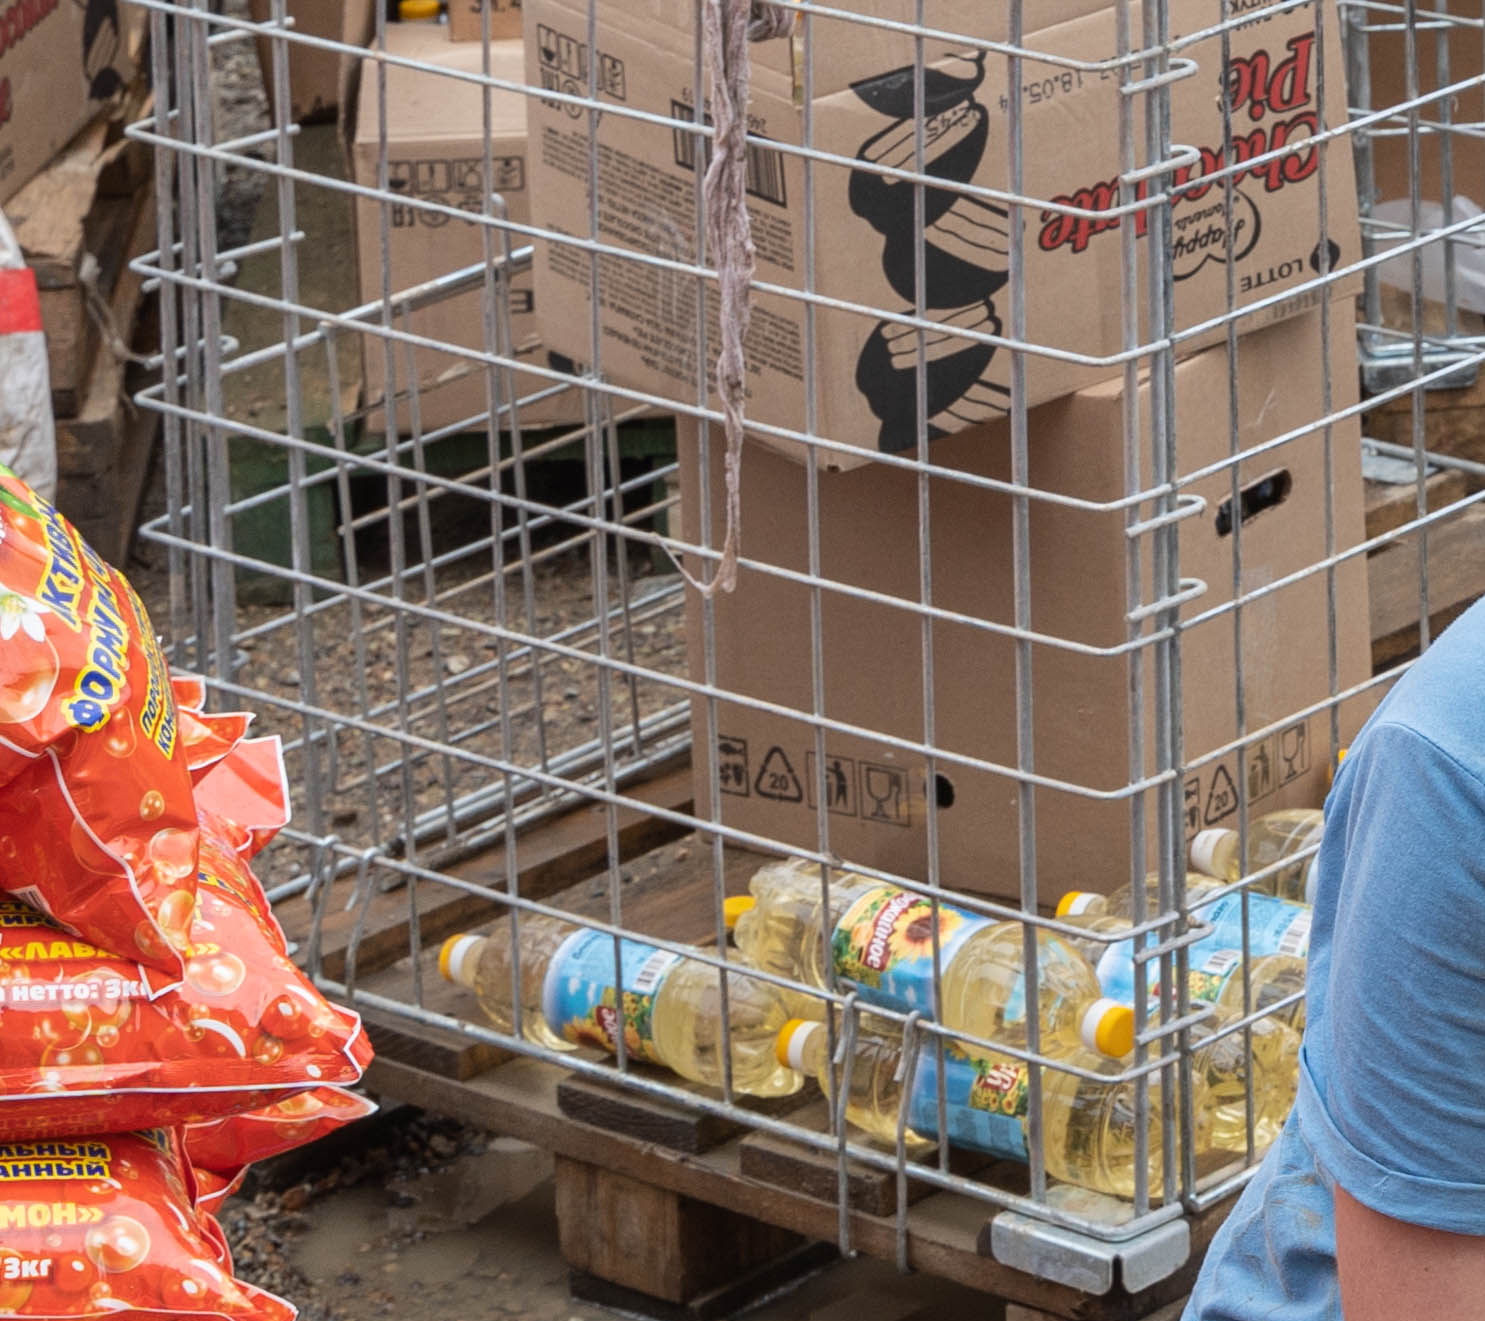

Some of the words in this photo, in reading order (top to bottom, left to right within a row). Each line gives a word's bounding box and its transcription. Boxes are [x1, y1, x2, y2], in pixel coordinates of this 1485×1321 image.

[1219, 32, 1315, 121] Pie
[1039, 110, 1322, 253] Choclate
[1240, 257, 1303, 292] LOTTE
[13, 981, 98, 1002] нетто:
[4, 1257, 52, 1278] 3кг
